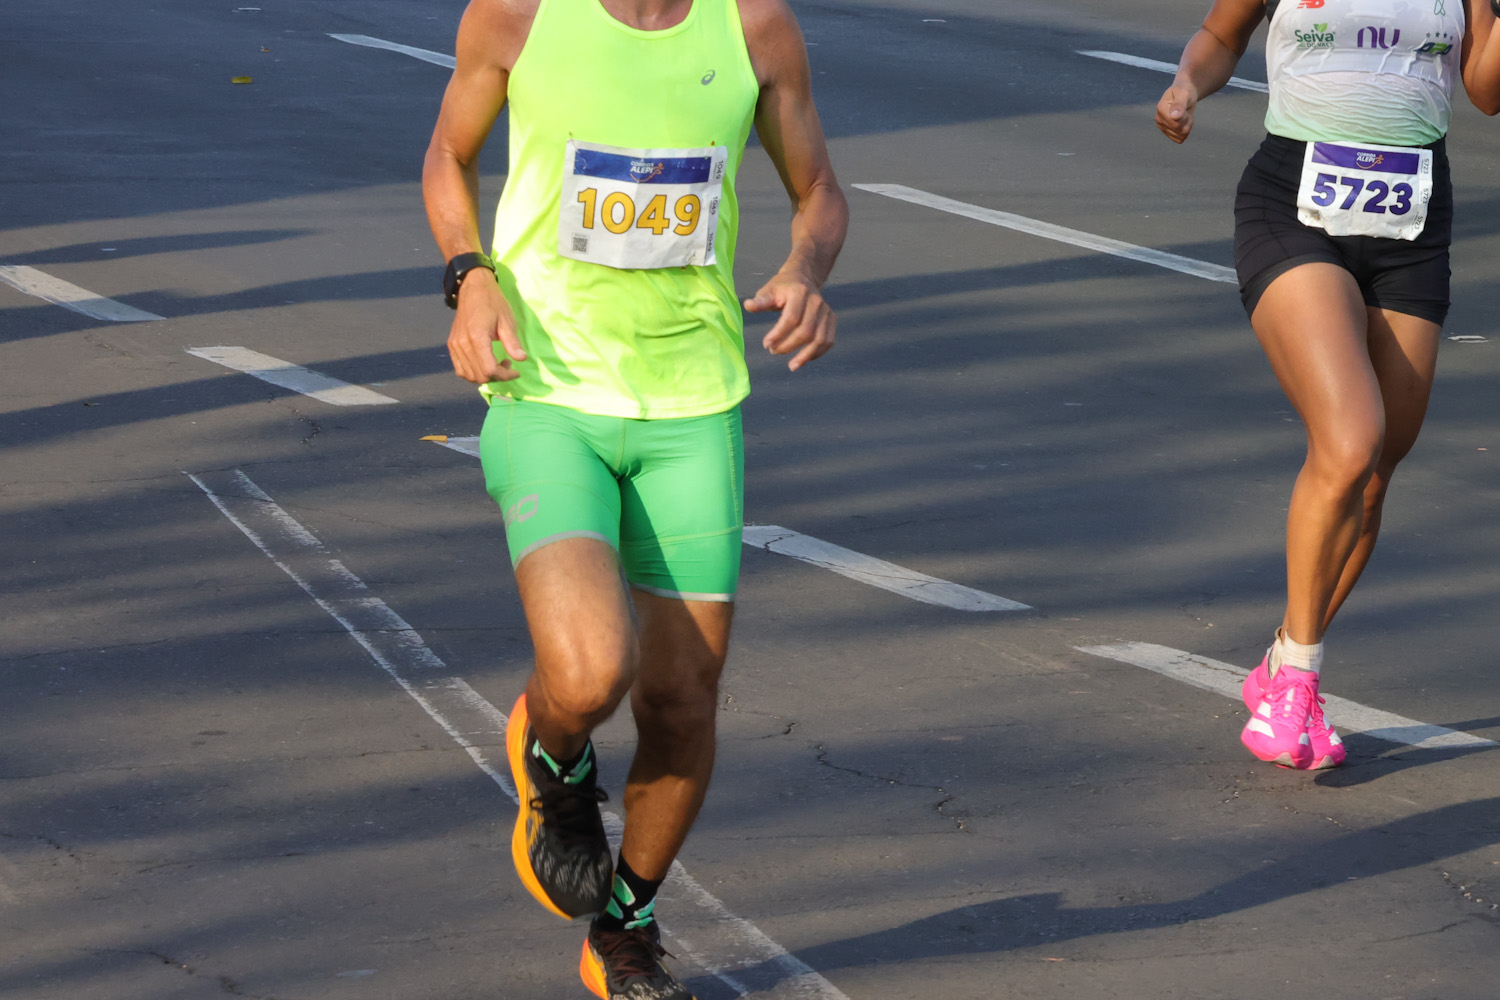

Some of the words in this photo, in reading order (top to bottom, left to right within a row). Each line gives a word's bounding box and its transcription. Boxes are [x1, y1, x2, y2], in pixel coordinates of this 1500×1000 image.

[1294, 29, 1334, 43] Seiva
[630, 166, 654, 174] ALEPI
[716, 160, 724, 180] 1049
[1311, 172, 1413, 216] 5723
[577, 187, 701, 236] 1049
